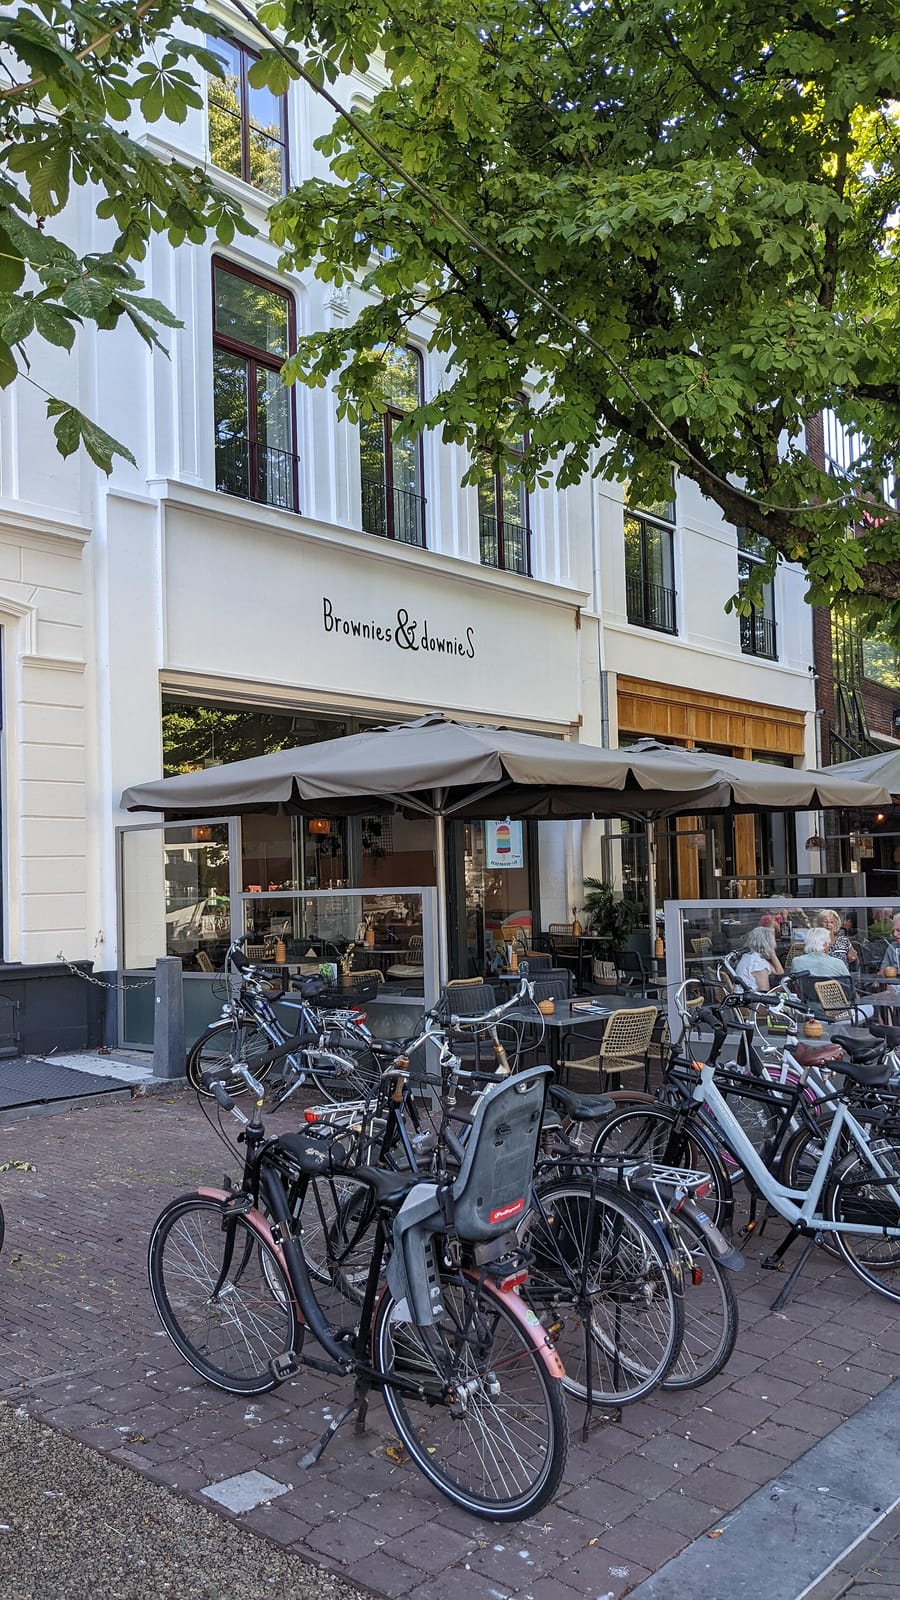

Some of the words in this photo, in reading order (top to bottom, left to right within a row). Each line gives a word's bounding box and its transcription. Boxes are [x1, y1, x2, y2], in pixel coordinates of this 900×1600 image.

[323, 597, 392, 642] Brownies
[395, 608, 420, 651] &
[421, 620, 475, 659] downieS
